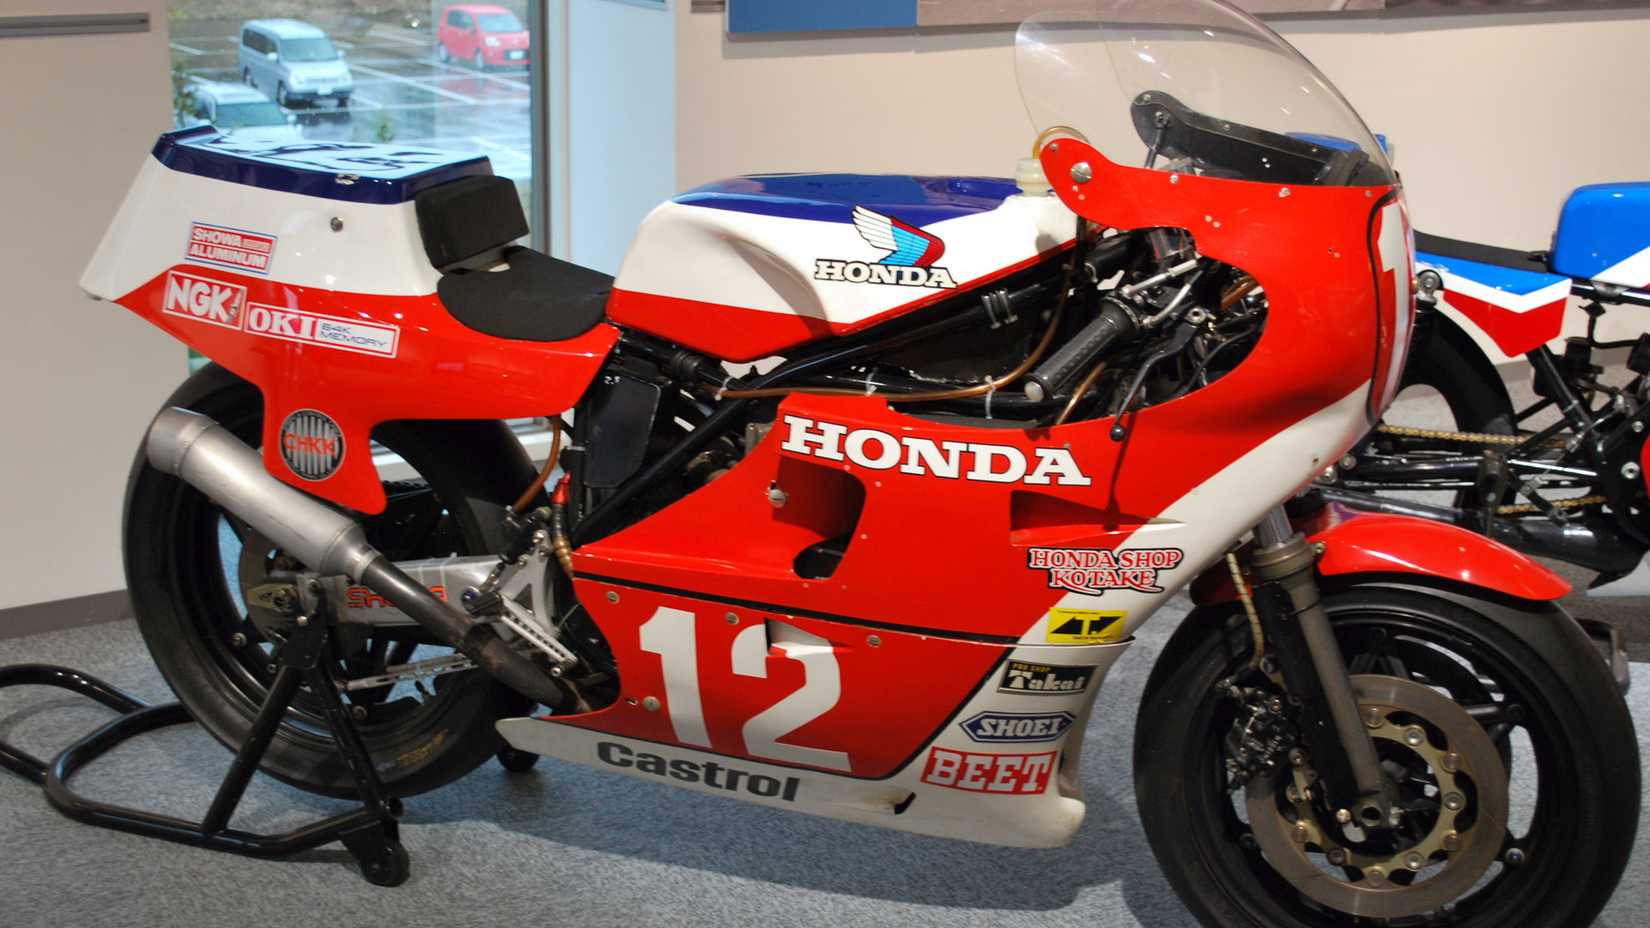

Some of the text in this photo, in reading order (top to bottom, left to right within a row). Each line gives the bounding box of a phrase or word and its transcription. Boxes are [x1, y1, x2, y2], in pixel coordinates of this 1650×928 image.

[190, 243, 266, 270] ALUMINUM
[814, 259, 957, 288] HONDA
[167, 277, 234, 323] NGK
[249, 308, 316, 340] OKI
[320, 330, 387, 347] MEMORY
[780, 414, 1093, 487] HONDA
[1030, 549, 1182, 569] HONDA SHOP
[1050, 569, 1164, 595] KOTAKE
[639, 606, 852, 773] 12
[1008, 669, 1086, 690] Takai
[977, 717, 1064, 737] SHOEI
[597, 741, 801, 802] Castrol
[927, 750, 1052, 792] BEET
